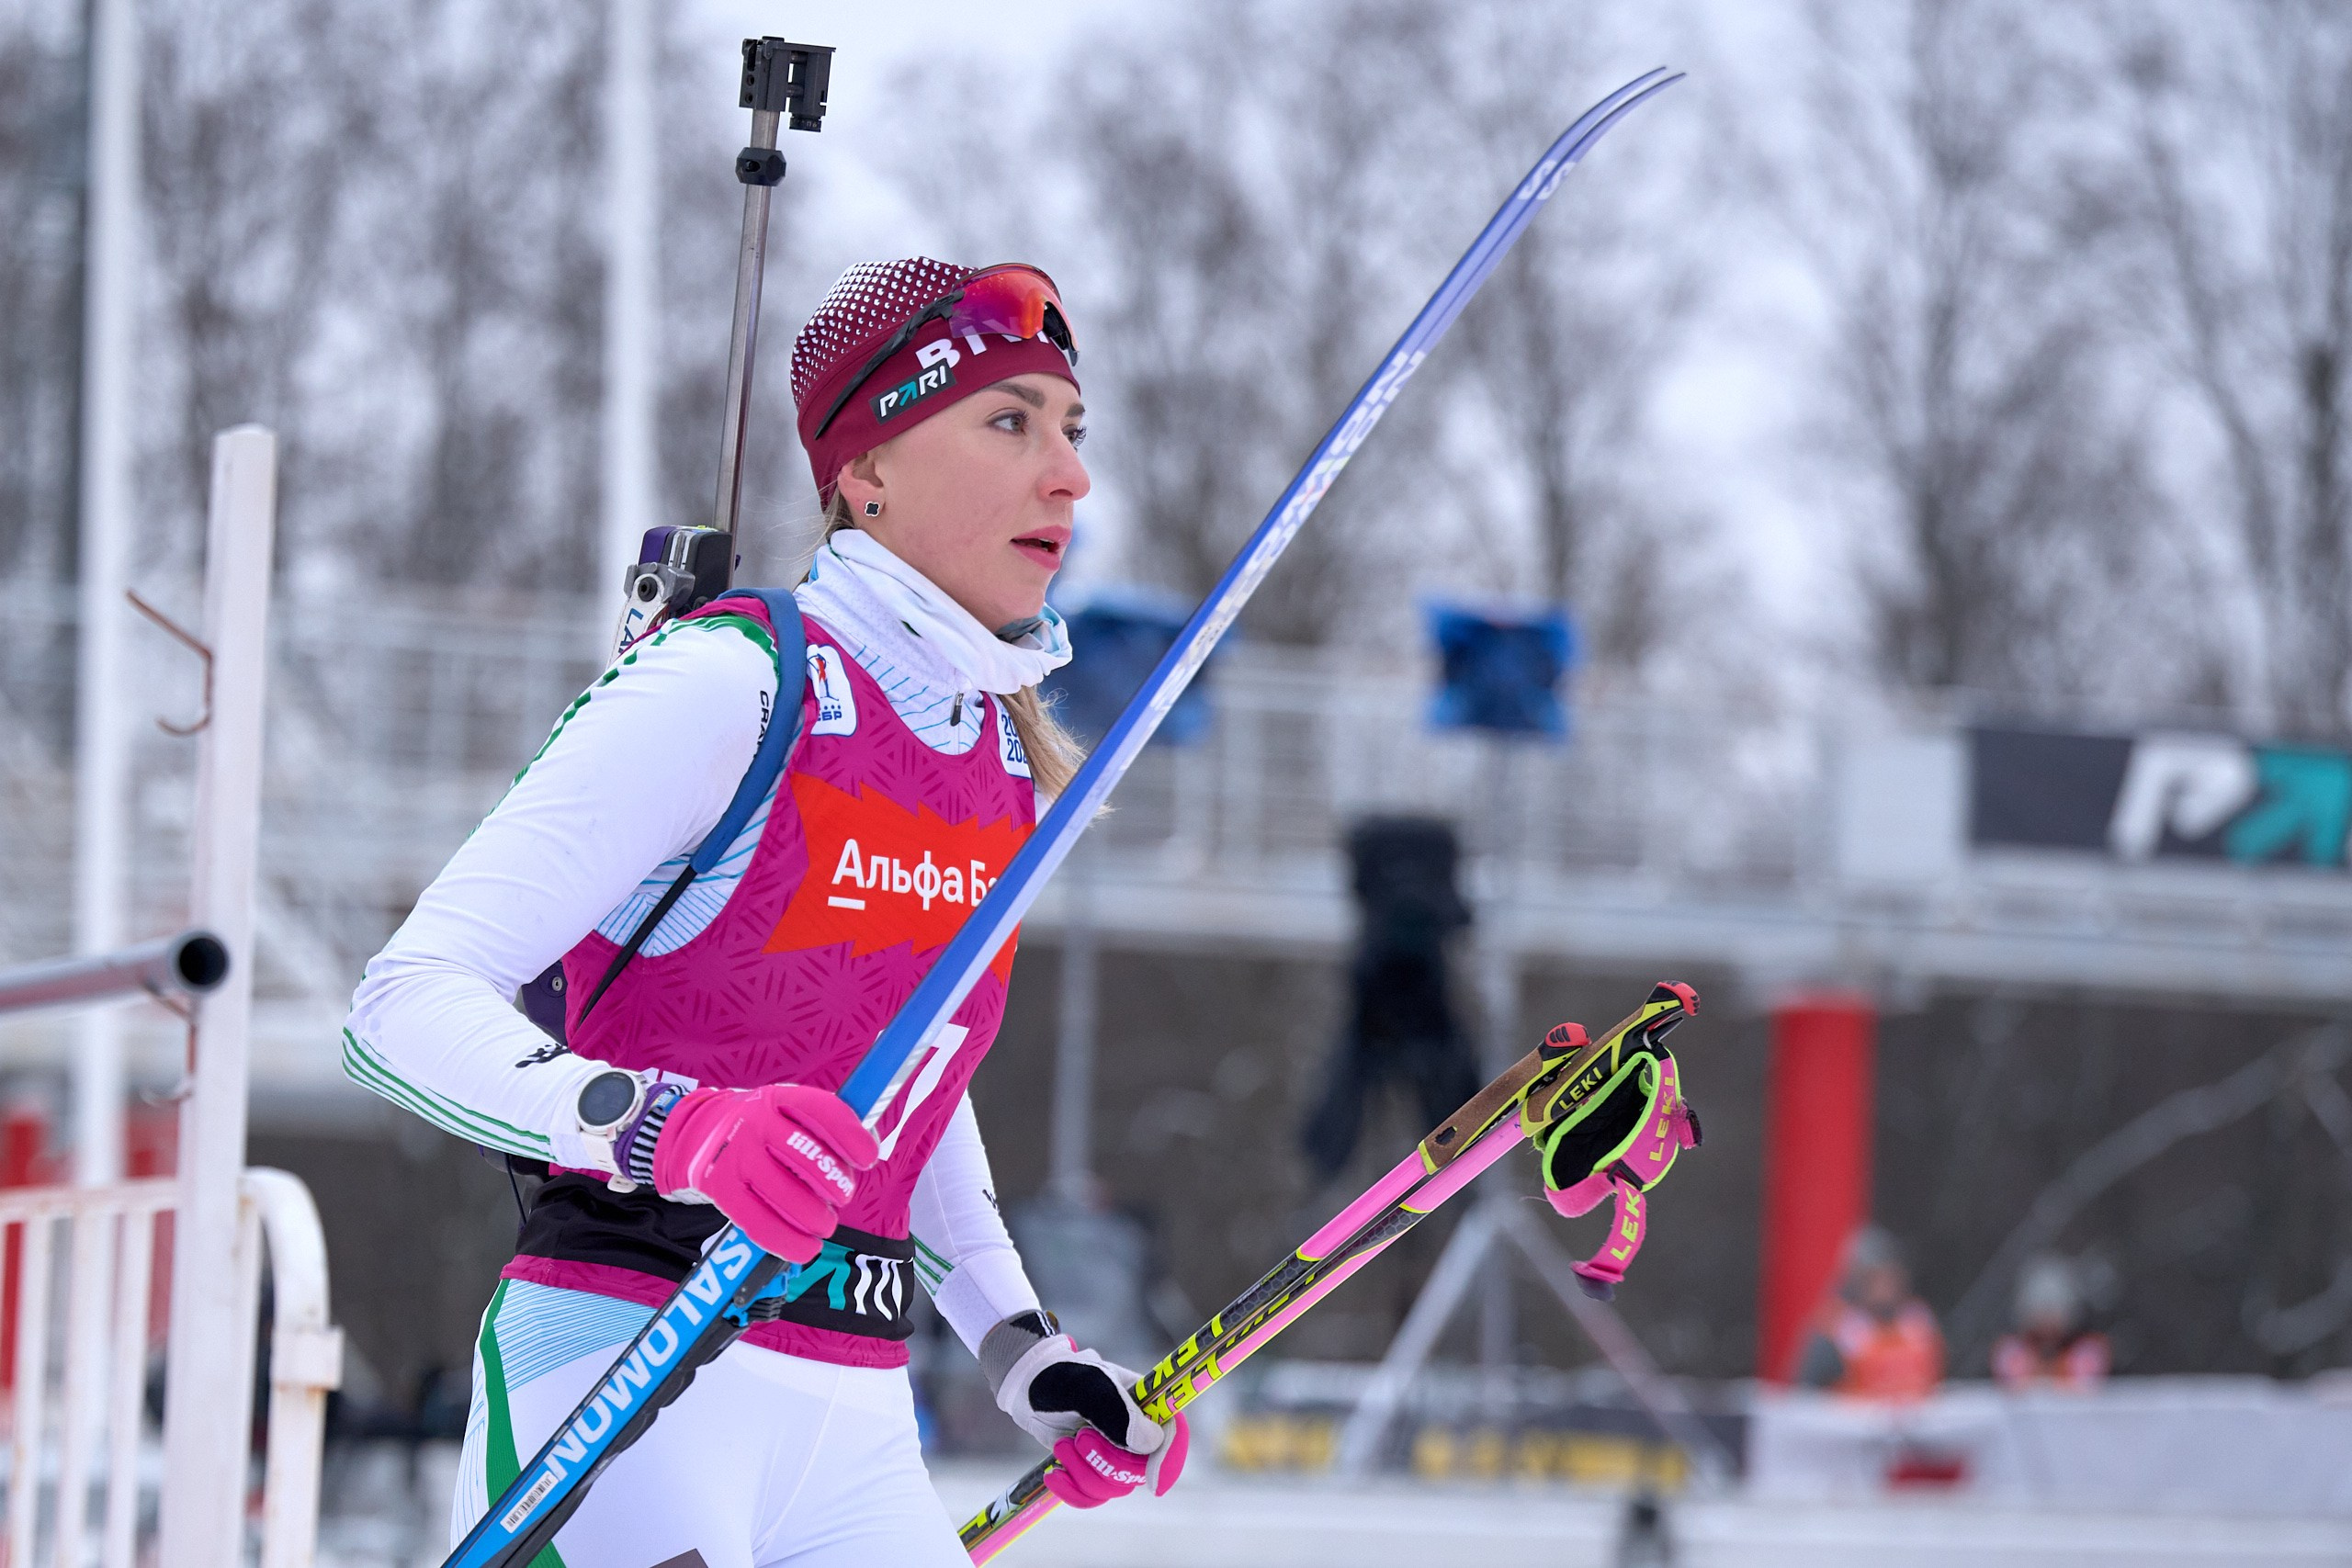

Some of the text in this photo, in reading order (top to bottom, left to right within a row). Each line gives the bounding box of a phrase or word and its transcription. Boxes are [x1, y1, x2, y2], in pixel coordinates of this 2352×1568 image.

[879, 365, 947, 418] PARI
[617, 607, 644, 654] LA
[752, 690, 770, 759] CRA
[2111, 735, 2352, 865] PA
[831, 838, 965, 911] Альфа
[1558, 1066, 1603, 1111] LEKI
[1649, 1077, 1675, 1162] LEKI
[1610, 1188, 1642, 1262] LEK
[541, 1227, 753, 1482] SALOMON
[1142, 1350, 1225, 1426] LEK
